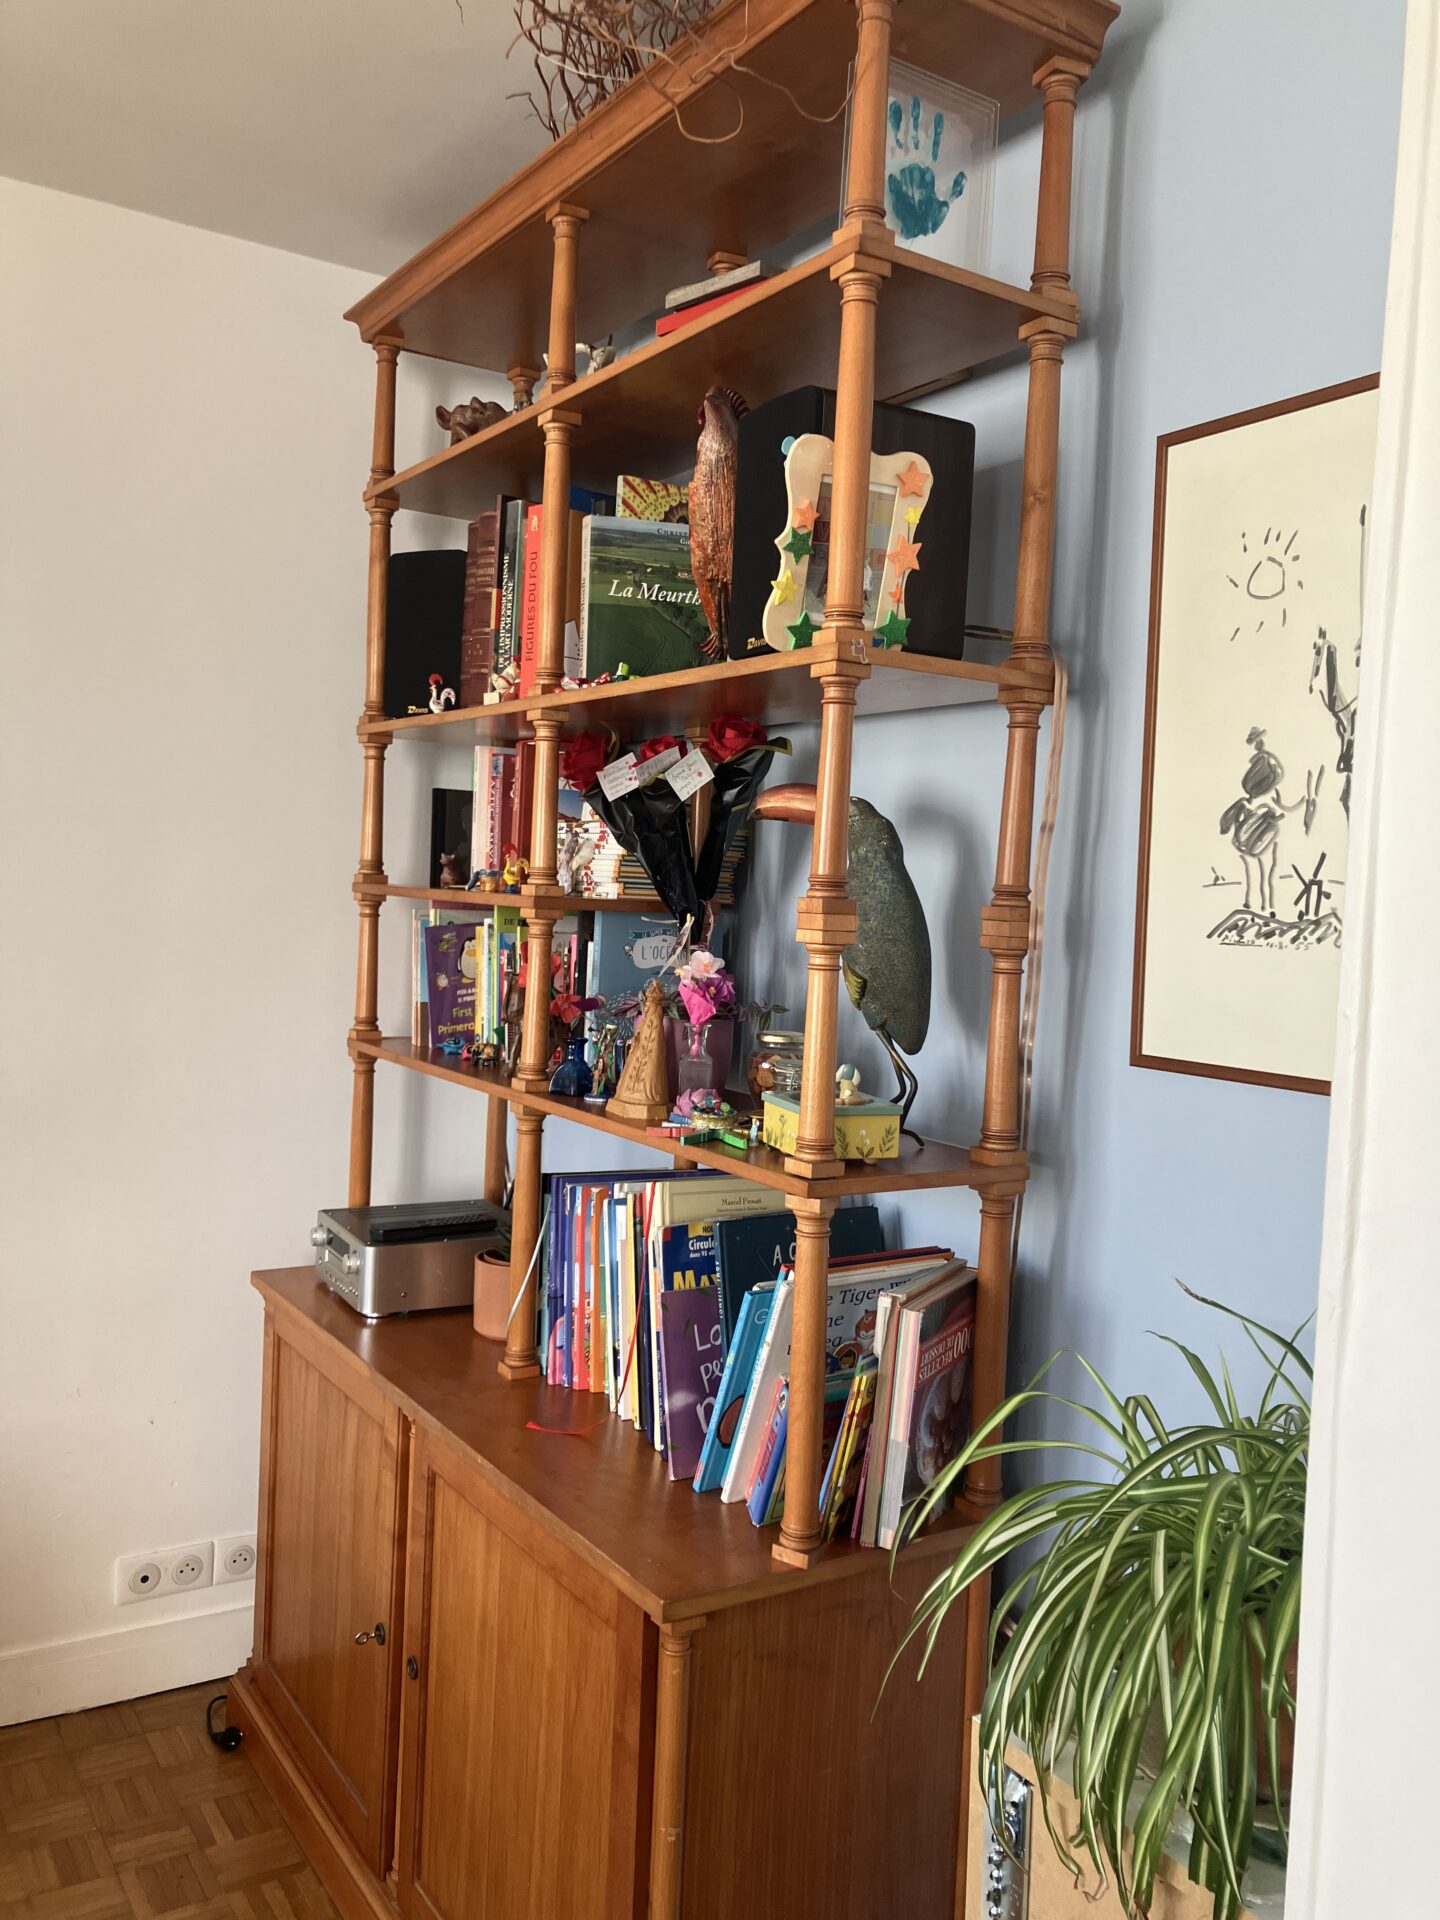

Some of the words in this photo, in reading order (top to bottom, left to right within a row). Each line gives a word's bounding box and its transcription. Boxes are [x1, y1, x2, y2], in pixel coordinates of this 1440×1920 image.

[529, 551, 538, 579] FOU
[528, 582, 537, 603] DU
[607, 579, 634, 598] La
[525, 606, 536, 662] FIGURES
[452, 1007, 473, 1018] First
[721, 1197, 742, 1206] Marcel
[742, 1196, 762, 1206] Proust
[917, 1348, 954, 1384] RECETTES
